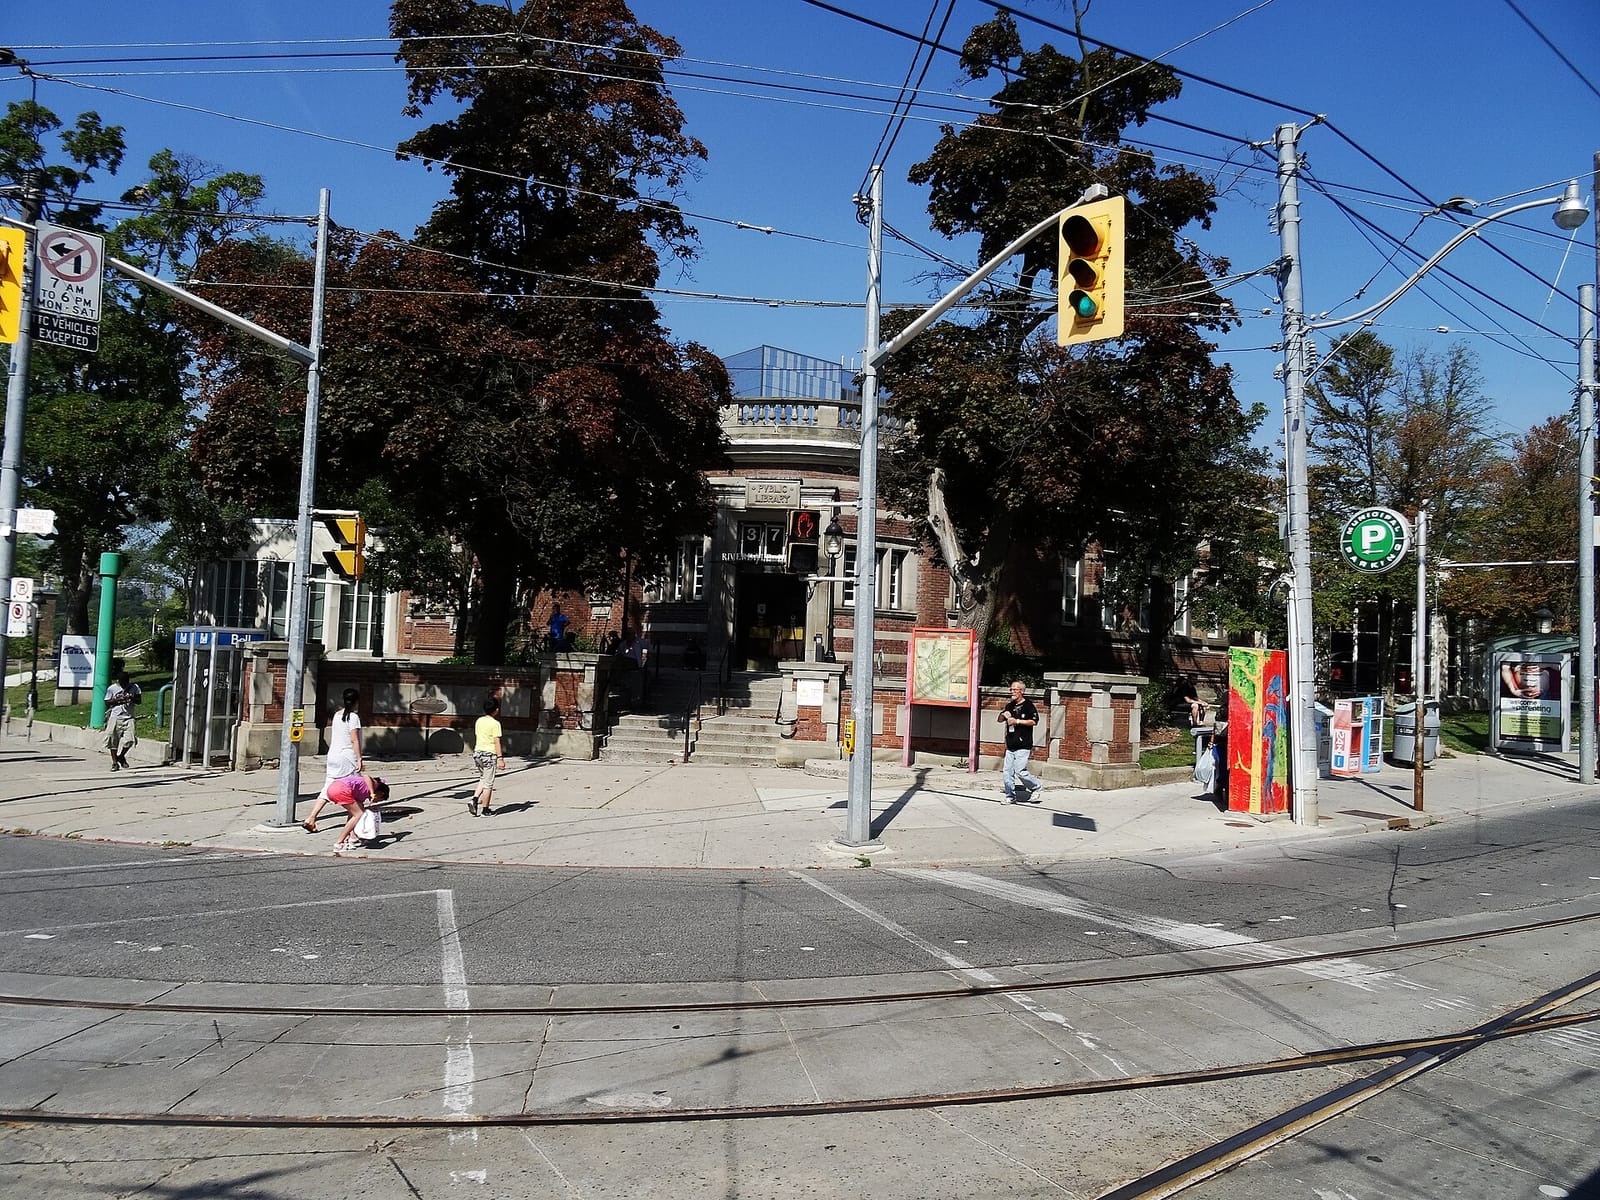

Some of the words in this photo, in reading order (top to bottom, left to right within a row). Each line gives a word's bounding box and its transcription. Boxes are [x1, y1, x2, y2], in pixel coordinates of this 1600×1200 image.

[50, 277, 59, 288] 7
[66, 283, 84, 295] AM
[38, 298, 62, 311] MON
[72, 306, 96, 318] SAT
[41, 289, 55, 300] TO
[61, 292, 70, 303] 6
[75, 297, 91, 308] PM
[52, 318, 97, 336] VEHICLES
[39, 328, 89, 347] EXCEPTED
[755, 495, 791, 504] LIBRARY
[1346, 511, 1401, 535] MUNICIPAL
[1361, 525, 1386, 549] P
[1345, 543, 1402, 569] PARKING
[1516, 704, 1552, 714] parenting
